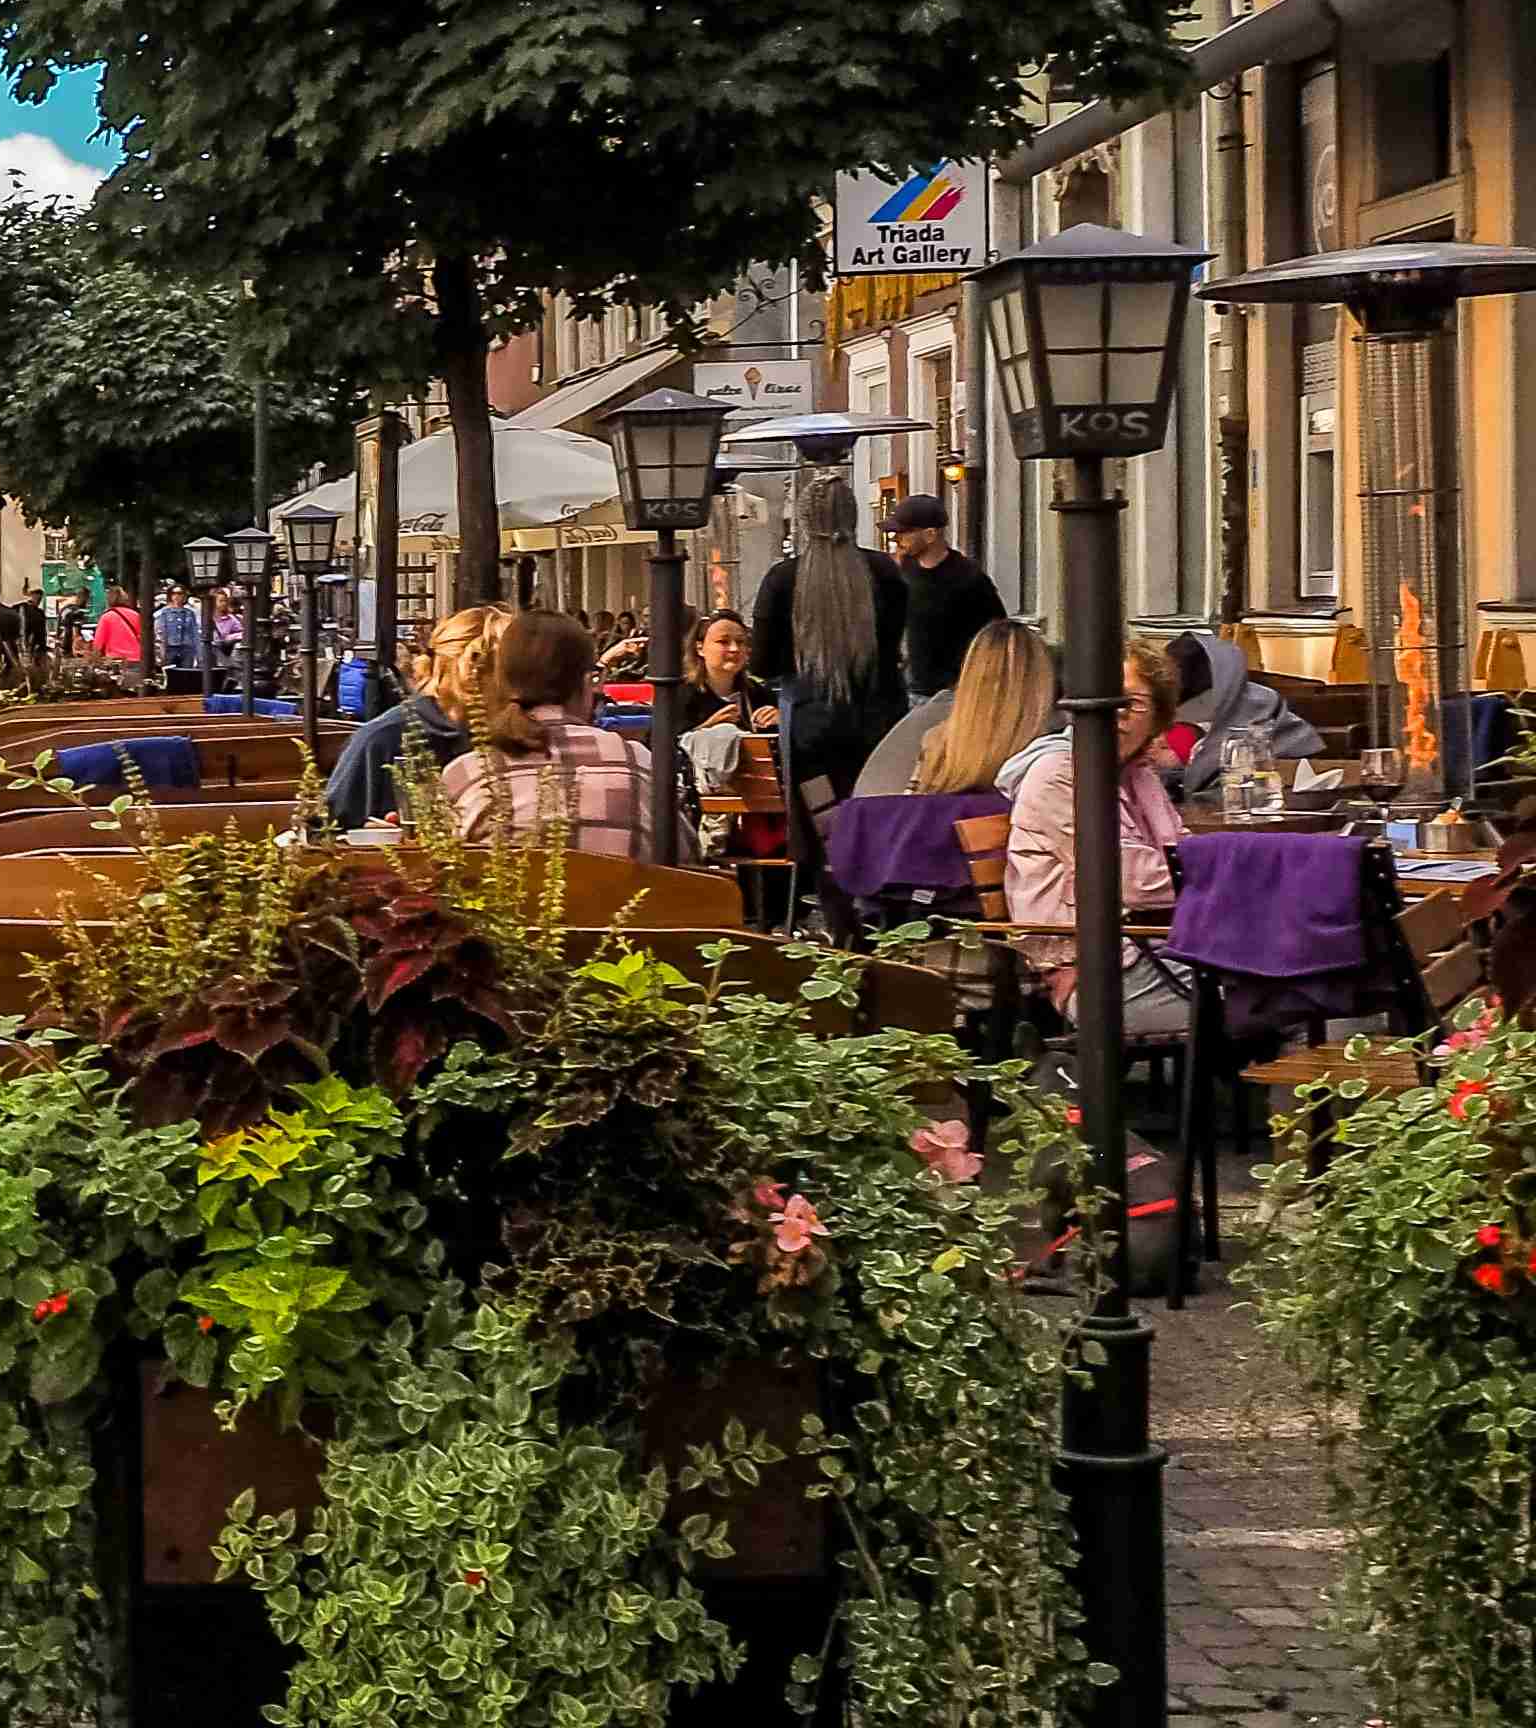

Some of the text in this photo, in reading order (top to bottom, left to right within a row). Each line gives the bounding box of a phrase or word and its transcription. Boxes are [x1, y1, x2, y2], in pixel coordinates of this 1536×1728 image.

[877, 224, 944, 243] Triada
[852, 245, 971, 265] Art Gallery
[1058, 411, 1150, 439] KOS
